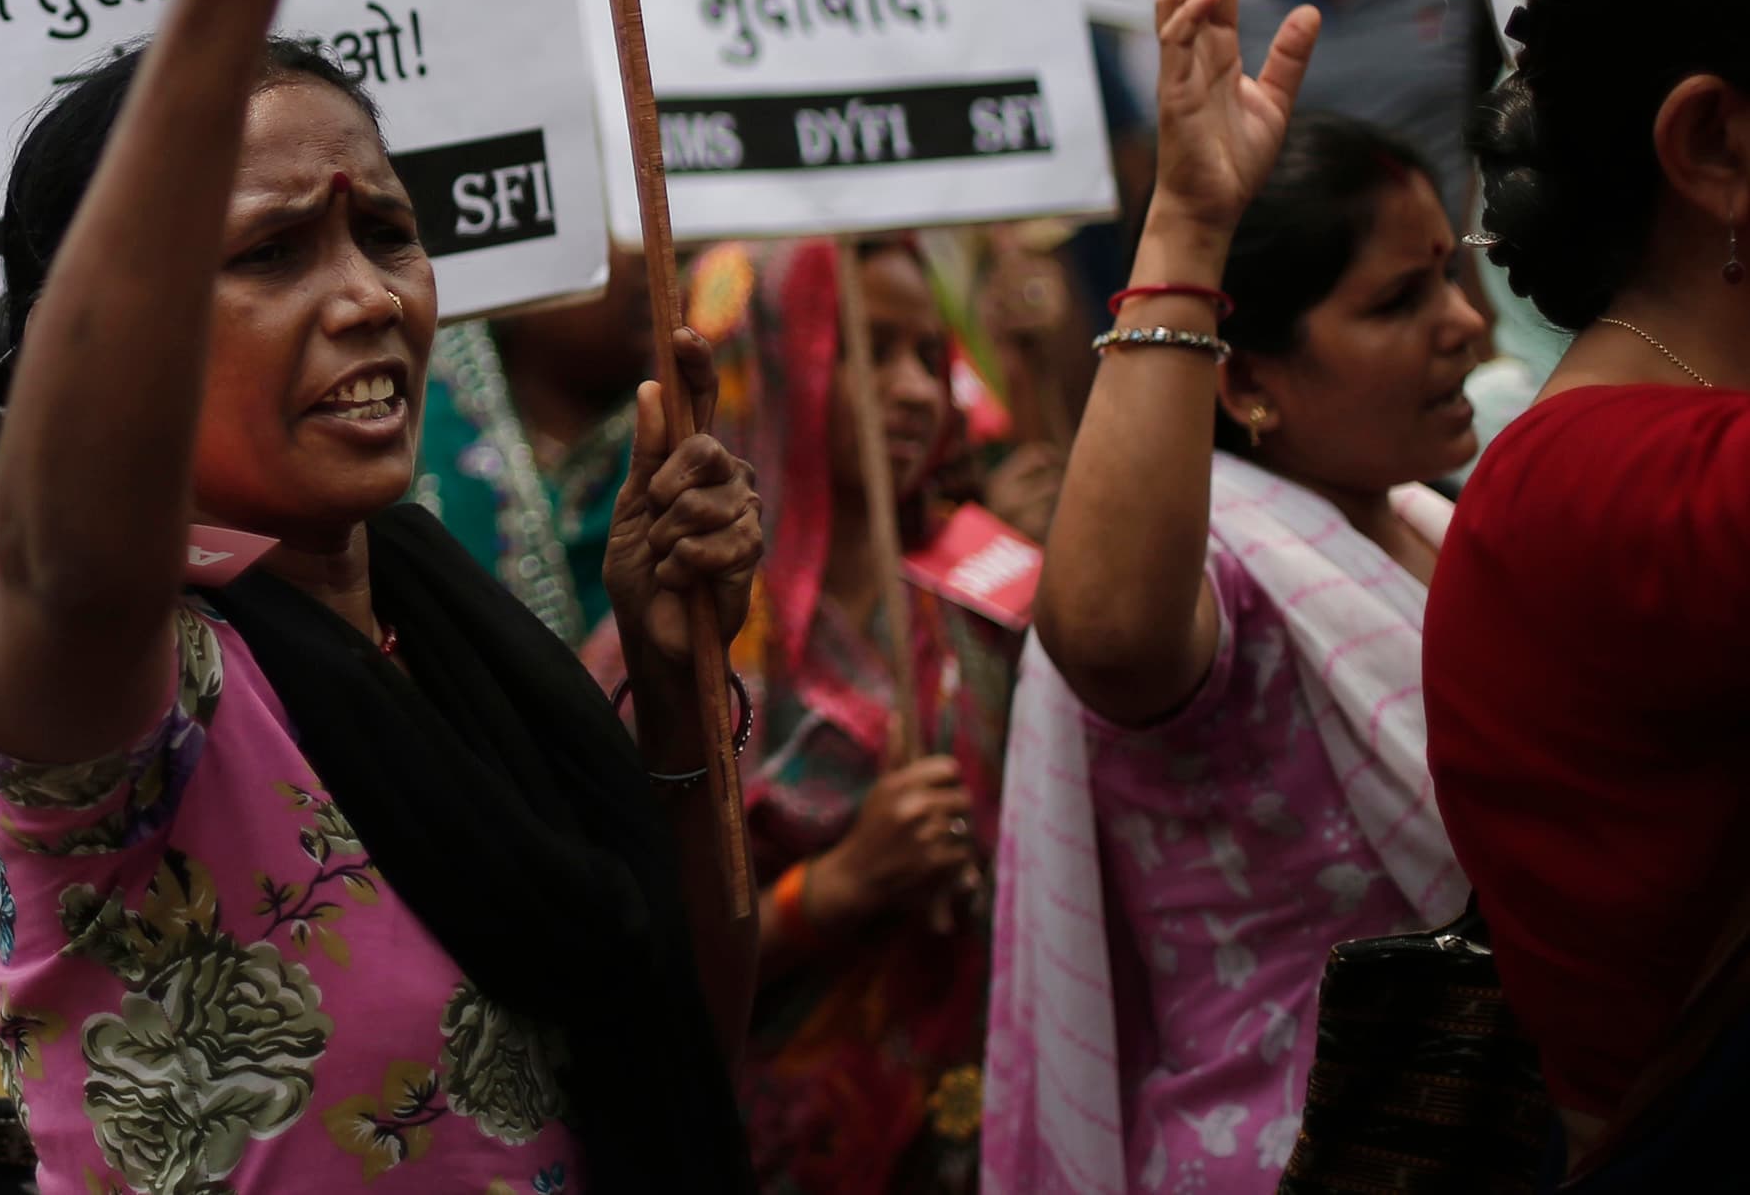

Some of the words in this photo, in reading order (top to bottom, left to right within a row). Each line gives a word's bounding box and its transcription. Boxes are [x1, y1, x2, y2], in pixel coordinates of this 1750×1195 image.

[793, 98, 914, 165] DYFI
[967, 94, 1052, 153] SFI
[452, 159, 554, 237] SFI
